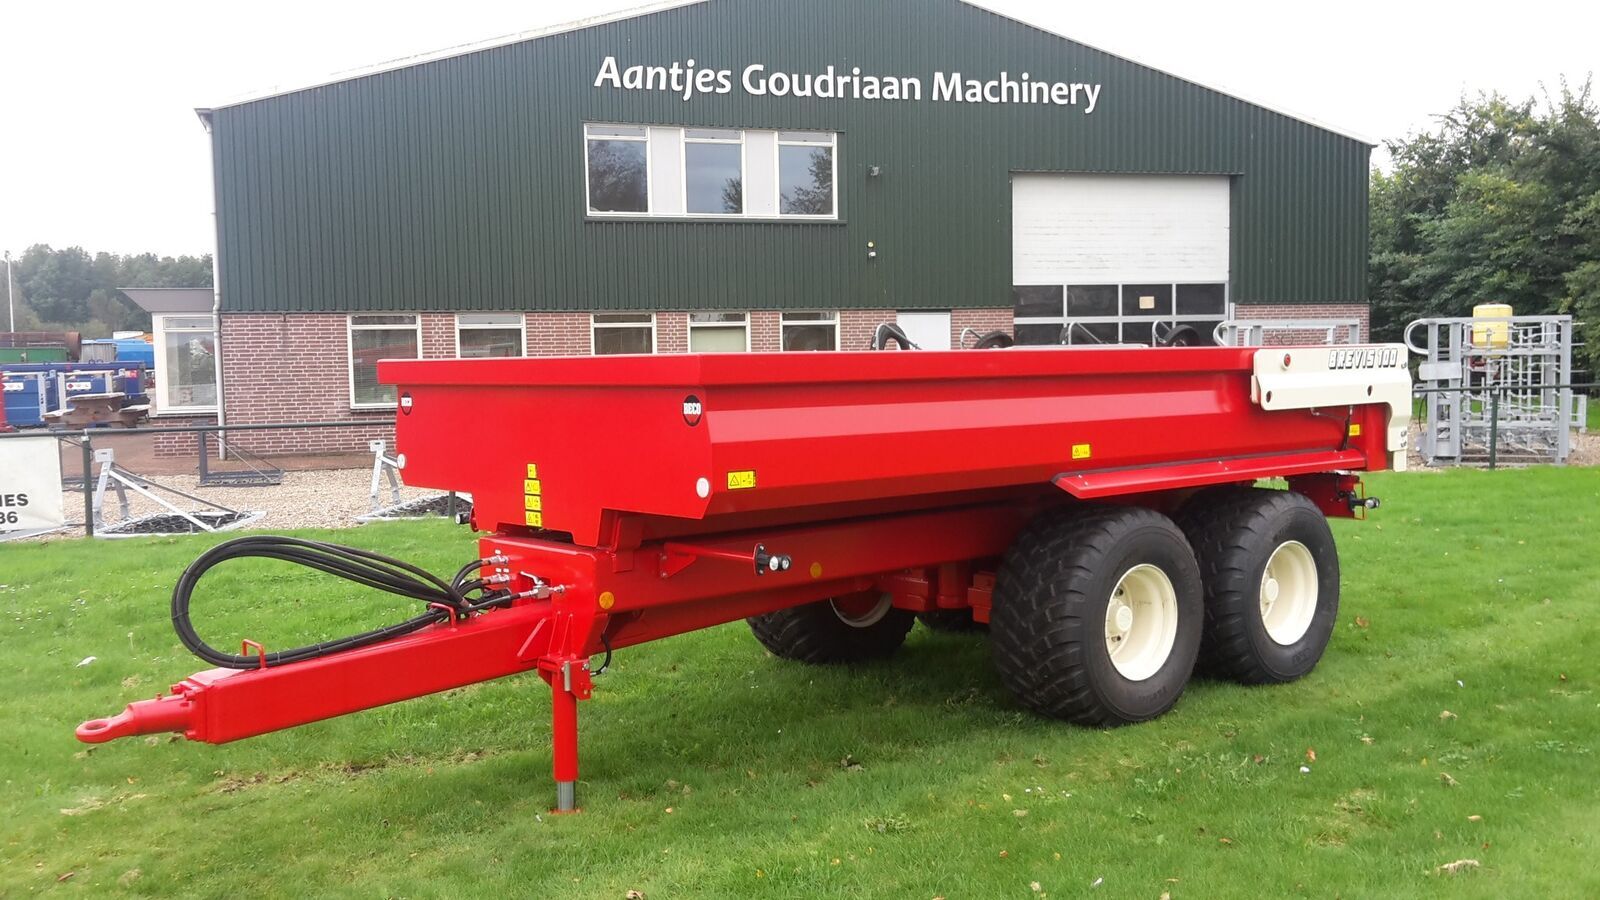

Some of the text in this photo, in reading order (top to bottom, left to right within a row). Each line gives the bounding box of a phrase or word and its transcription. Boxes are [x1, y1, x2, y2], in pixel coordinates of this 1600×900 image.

[594, 56, 1101, 113] Aantjes Goudriaan Machinery
[1328, 348, 1398, 370] BREVIS 100
[0, 493, 29, 507] ES
